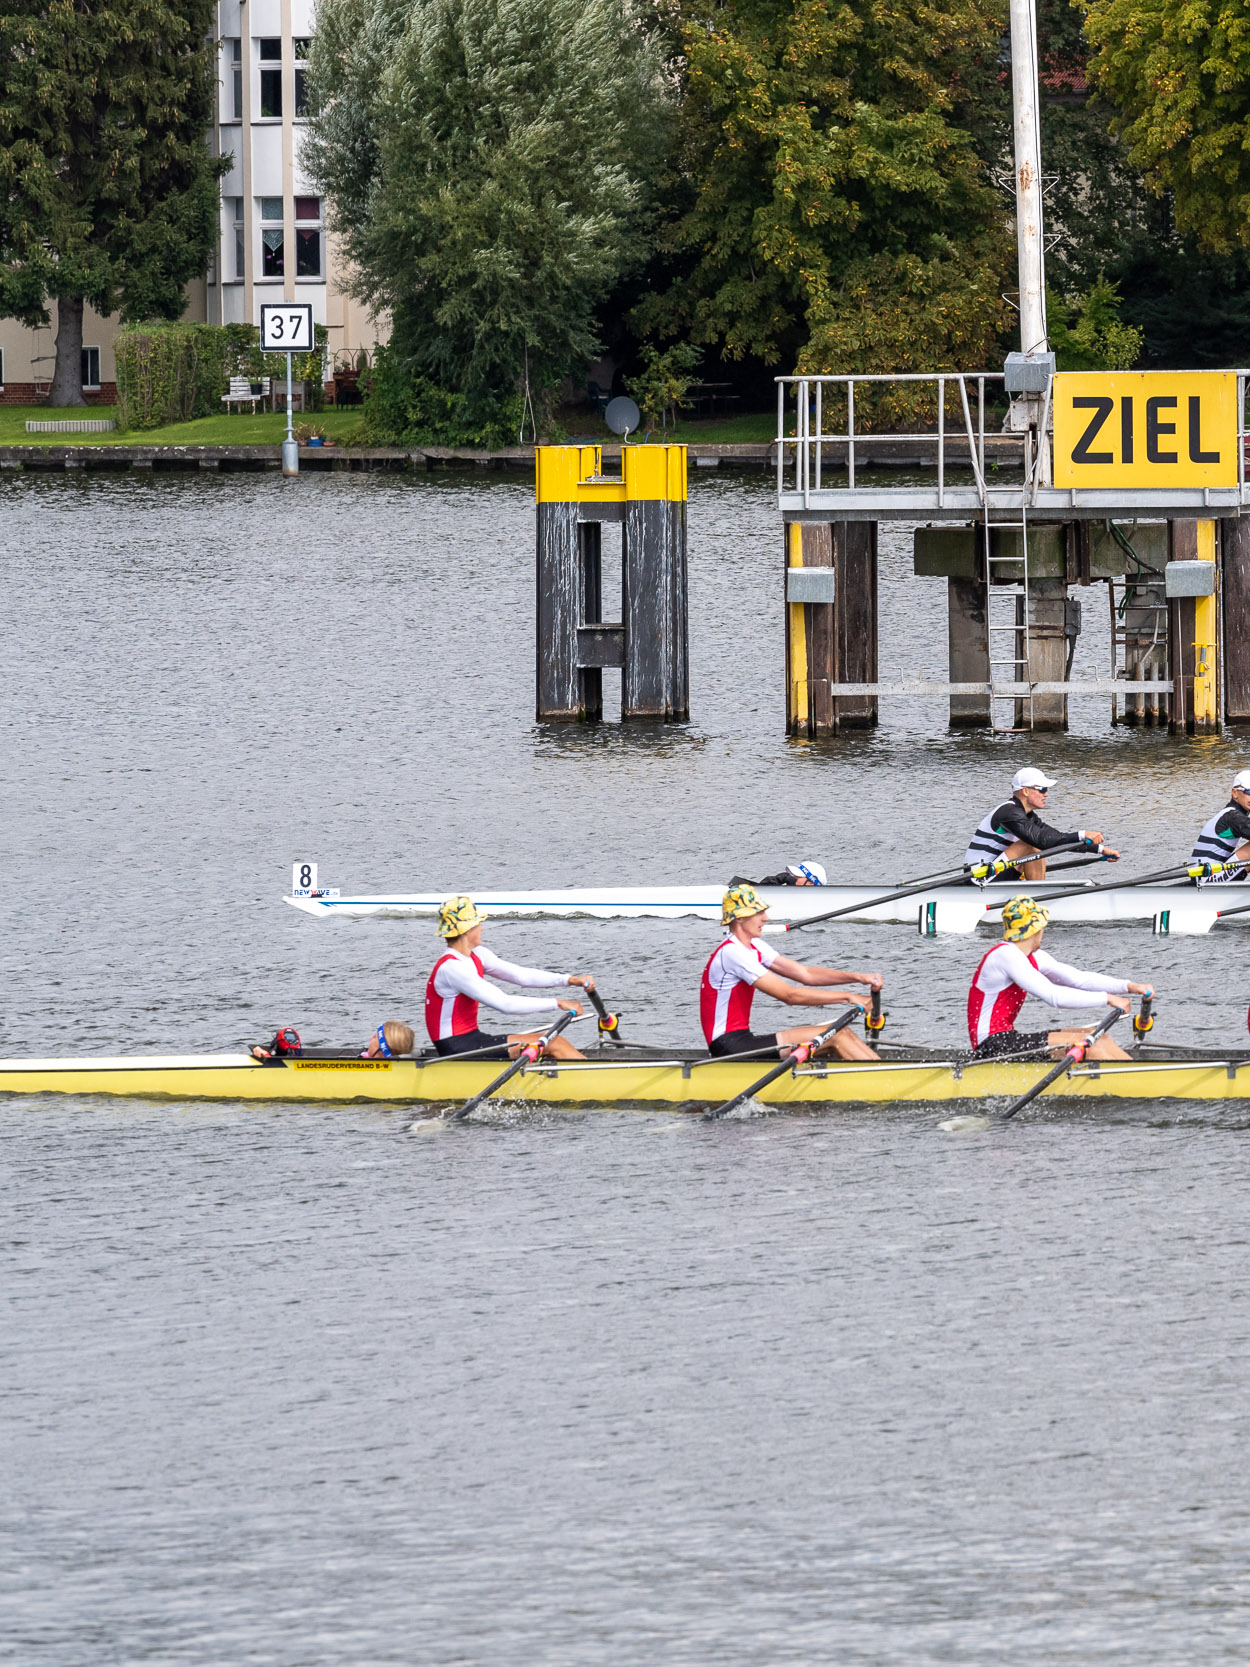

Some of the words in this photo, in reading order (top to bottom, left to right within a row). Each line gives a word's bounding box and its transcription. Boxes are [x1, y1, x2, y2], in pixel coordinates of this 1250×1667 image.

[271, 315, 302, 339] 37
[1071, 396, 1220, 464] ZIEL
[300, 864, 311, 888] 8
